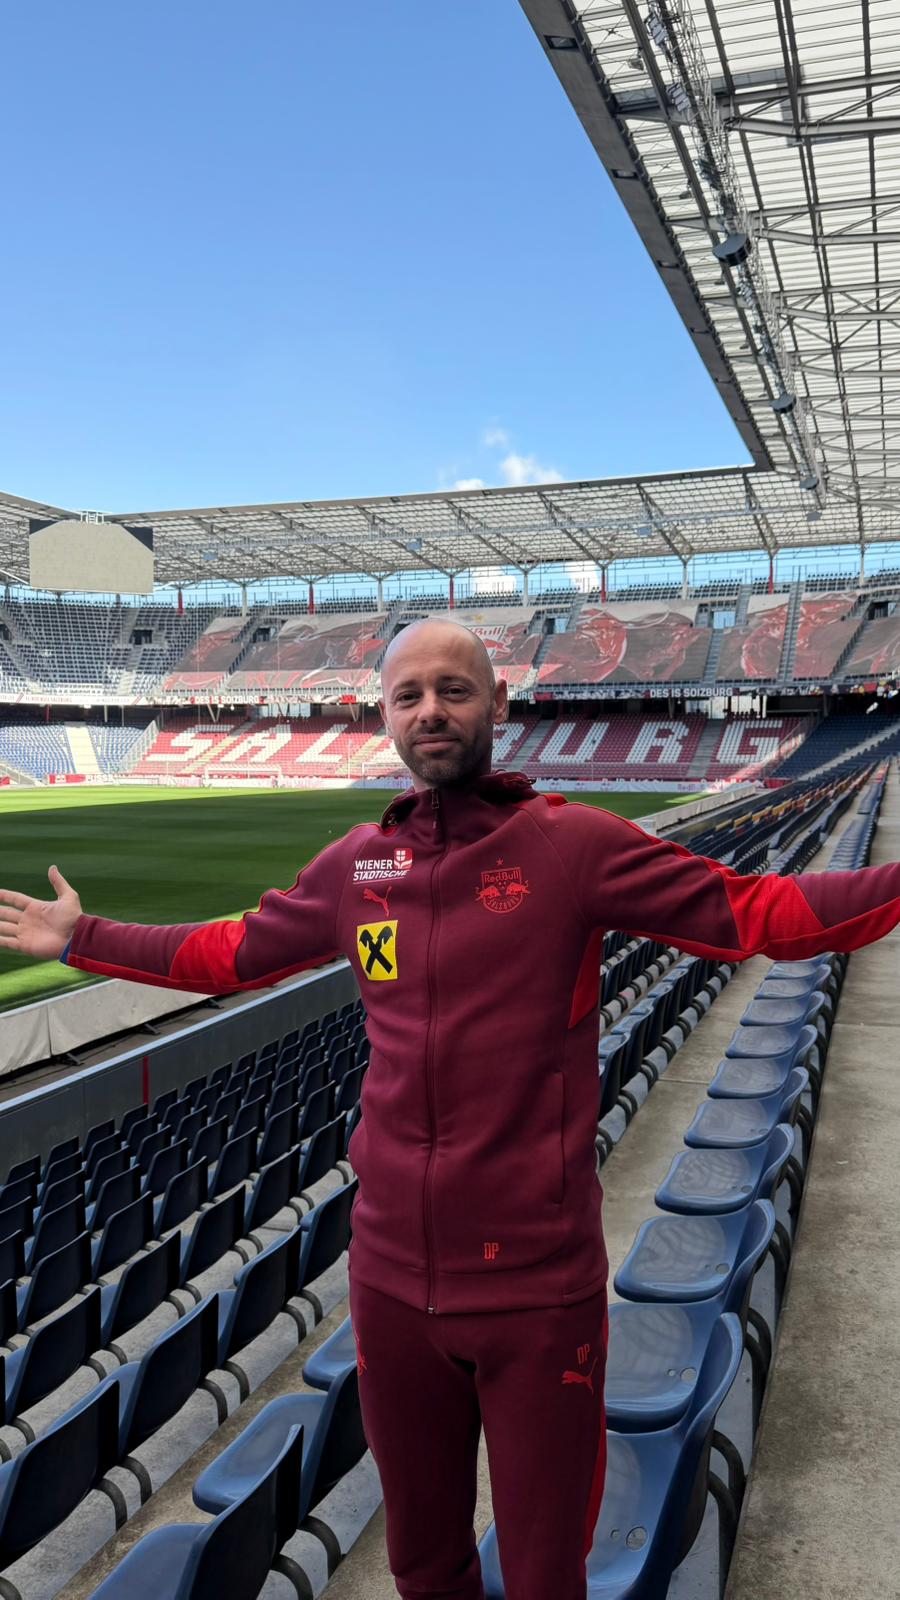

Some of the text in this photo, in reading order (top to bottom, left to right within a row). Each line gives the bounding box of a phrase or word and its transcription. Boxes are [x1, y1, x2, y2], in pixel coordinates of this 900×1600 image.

[649, 687, 733, 698] DES IS SOIZBURG
[194, 695, 210, 705] DES
[355, 859, 393, 870] WIENER
[353, 869, 410, 881] STÄDTISCHE
[484, 1242, 500, 1260] DP
[577, 1343, 591, 1365] DP
